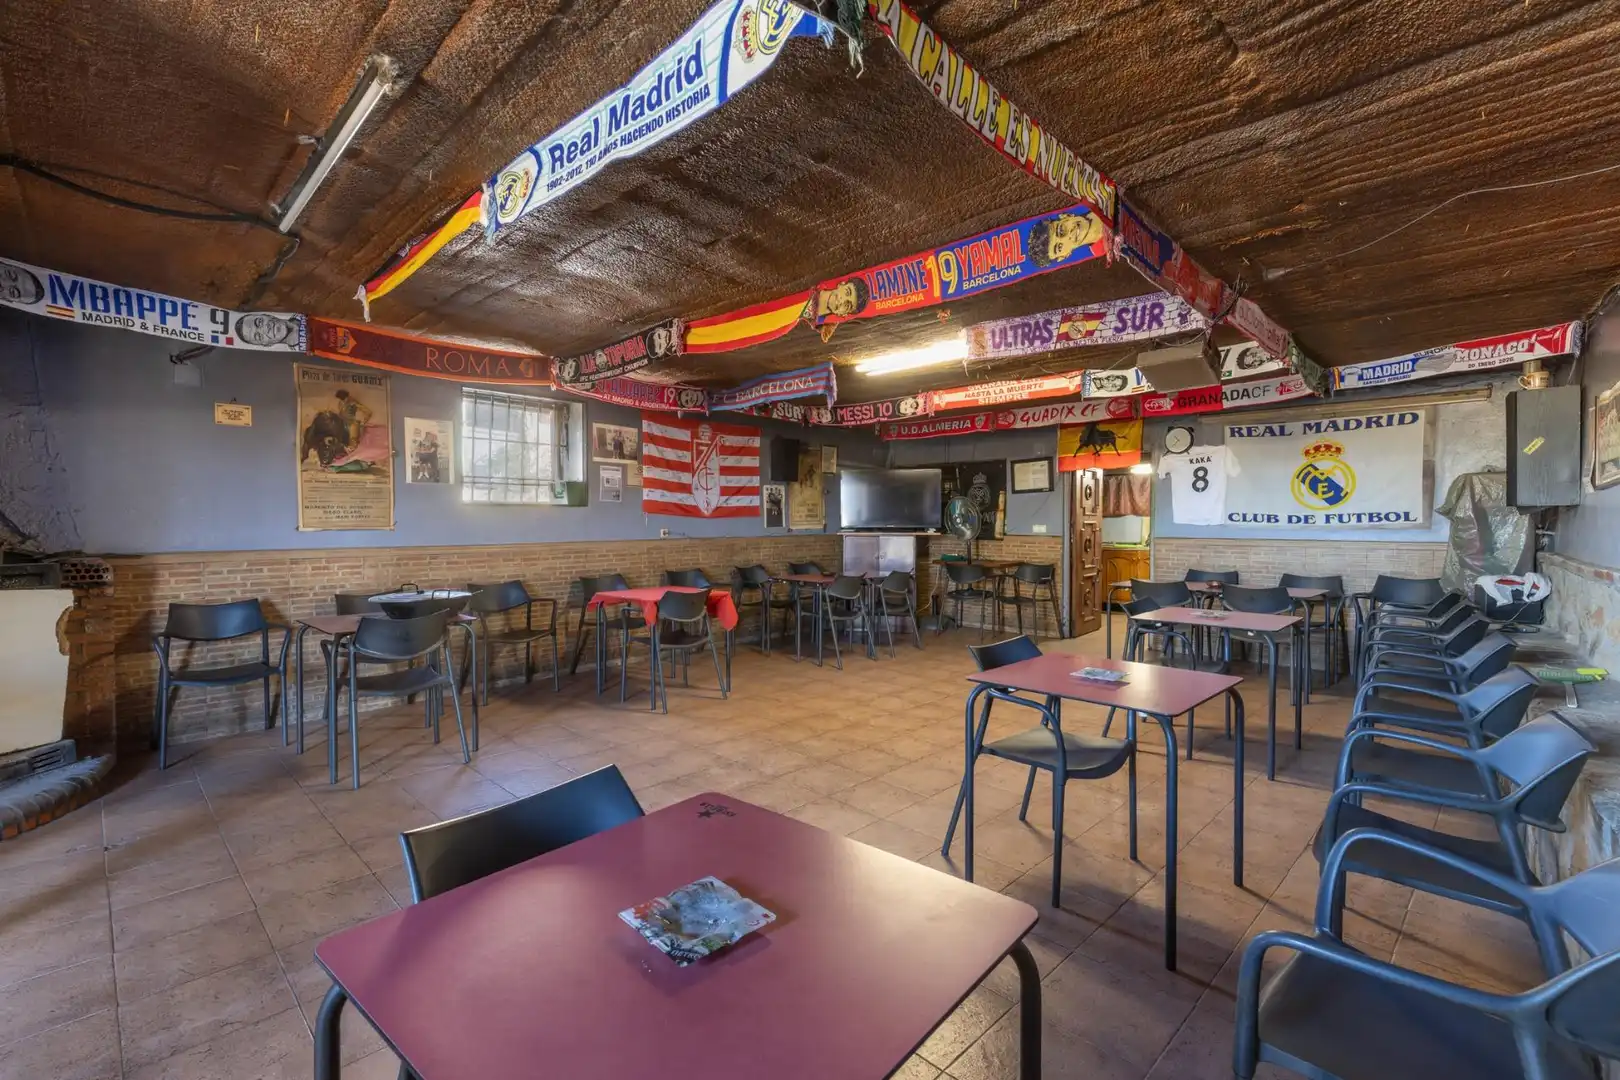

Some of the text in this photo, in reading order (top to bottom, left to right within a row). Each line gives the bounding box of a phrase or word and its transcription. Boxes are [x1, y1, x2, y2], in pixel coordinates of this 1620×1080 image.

[910, 21, 1002, 142] CALLE
[1003, 96, 1032, 165] ES
[549, 39, 703, 174] Real Madrid
[620, 116, 664, 149] HACIENDO
[665, 82, 711, 127] HISTORIA
[865, 228, 1026, 301] LAMINE 19 YAMAL
[962, 266, 1022, 291] BARCELONA
[874, 293, 925, 310] BARCELONA
[82, 312, 205, 342] MADRID & FRANCE
[210, 309, 230, 335] 9
[991, 302, 1165, 349] ULTRAS SUR
[425, 346, 512, 377] ROMA
[1455, 339, 1529, 363] MONACO
[1362, 361, 1413, 380] MADRID
[663, 387, 676, 403] 19
[735, 377, 814, 402] BARCELONA
[964, 382, 1045, 398] HASTA LA MUERTE
[978, 392, 1029, 405] SIEMPRE
[837, 405, 874, 421] MESSI
[876, 402, 892, 417] 10
[1080, 402, 1104, 418] CF
[1229, 412, 1420, 438] REAL MADRID
[1191, 466, 1209, 493] 8
[1227, 511, 1417, 525] CLUB DE FUTBOL
